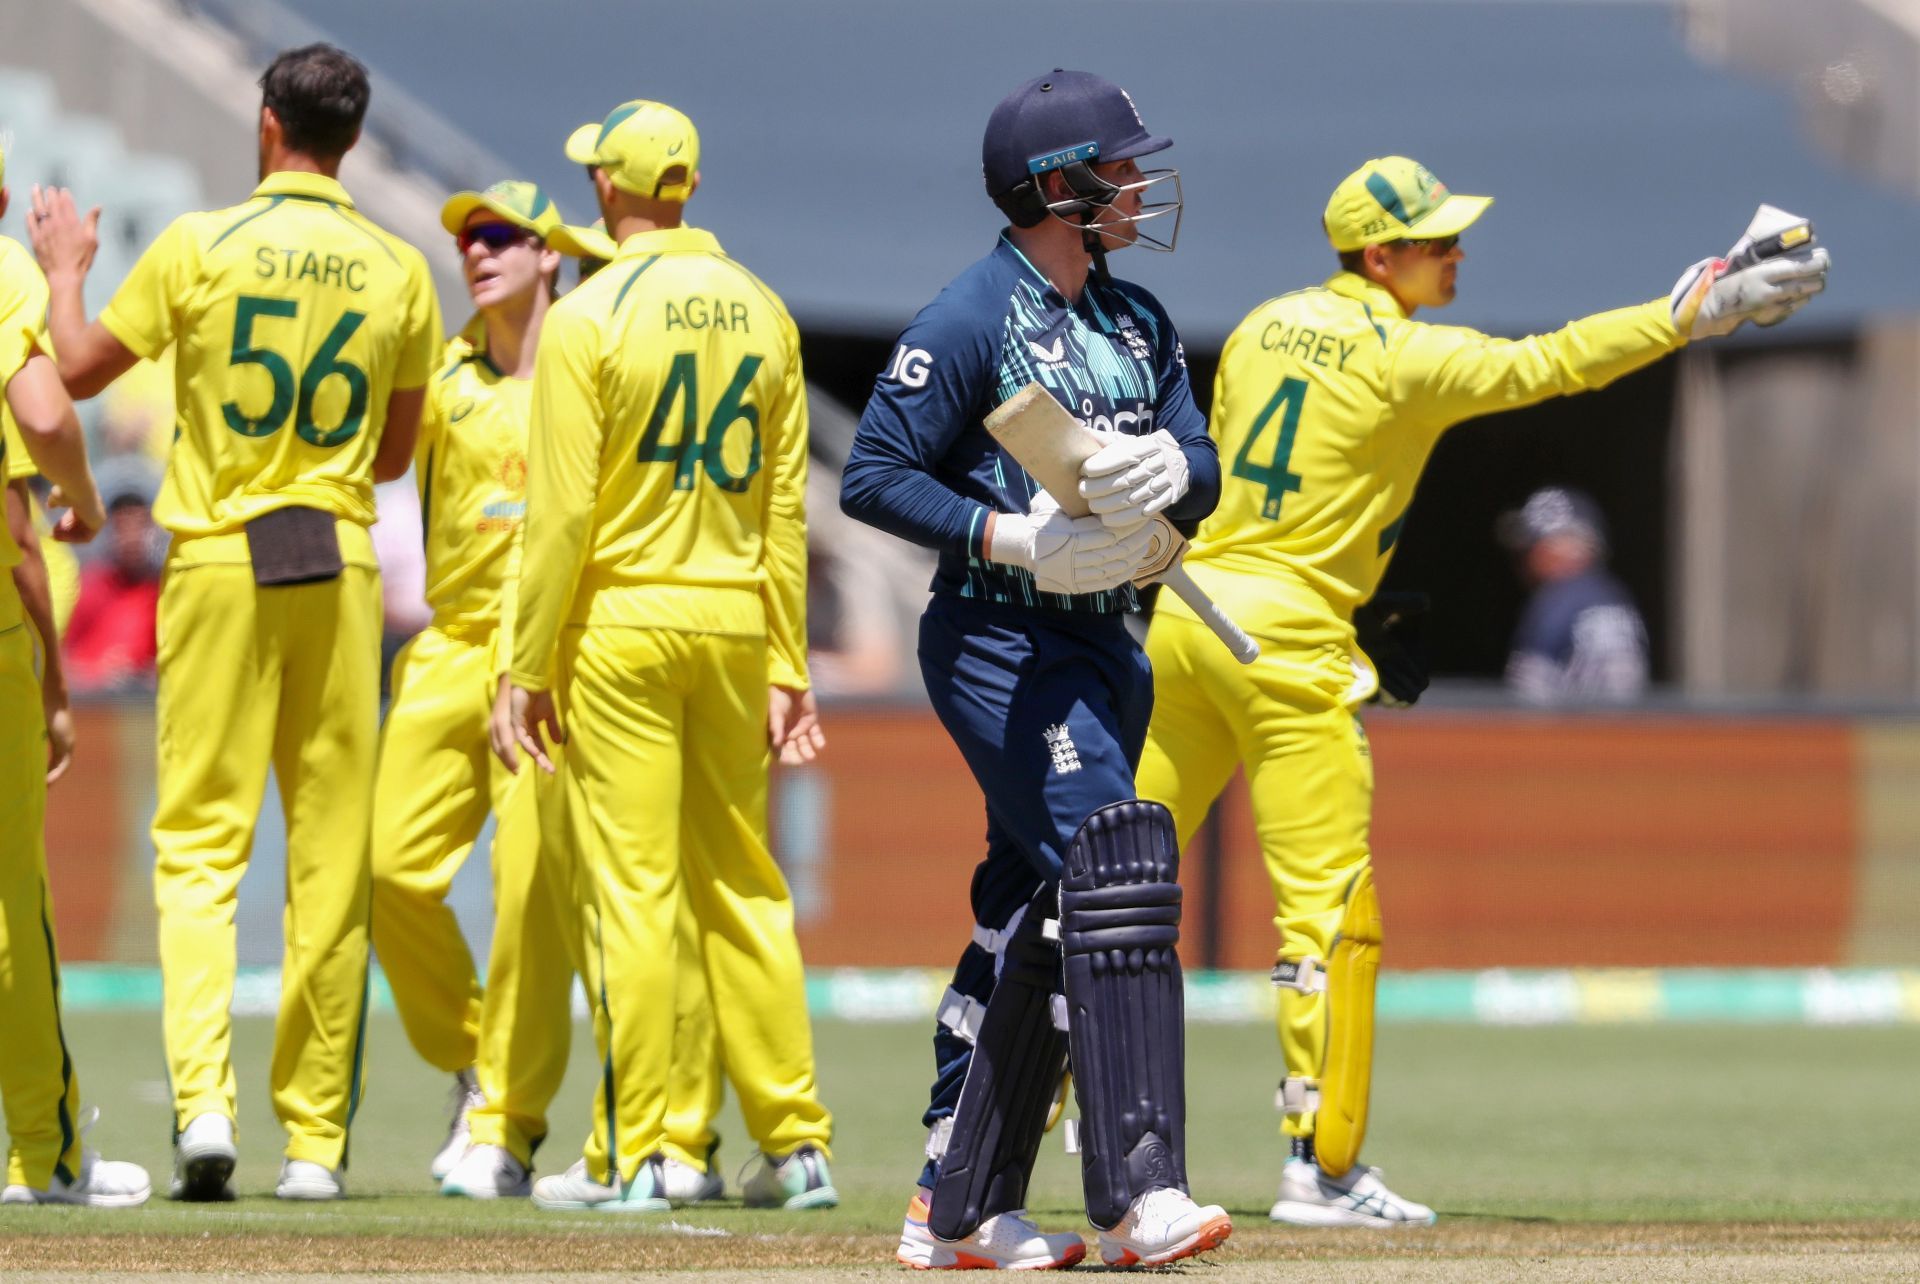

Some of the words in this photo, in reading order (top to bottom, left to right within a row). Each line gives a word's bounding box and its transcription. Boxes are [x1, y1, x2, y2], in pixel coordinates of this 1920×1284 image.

[1053, 151, 1076, 167] AIR
[255, 246, 367, 292] STARC
[665, 297, 750, 333] AGAR
[221, 295, 369, 447] 56
[889, 344, 933, 388] IG
[1261, 320, 1357, 373] CAREY
[637, 352, 763, 492] 46
[1231, 375, 1308, 521] 4
